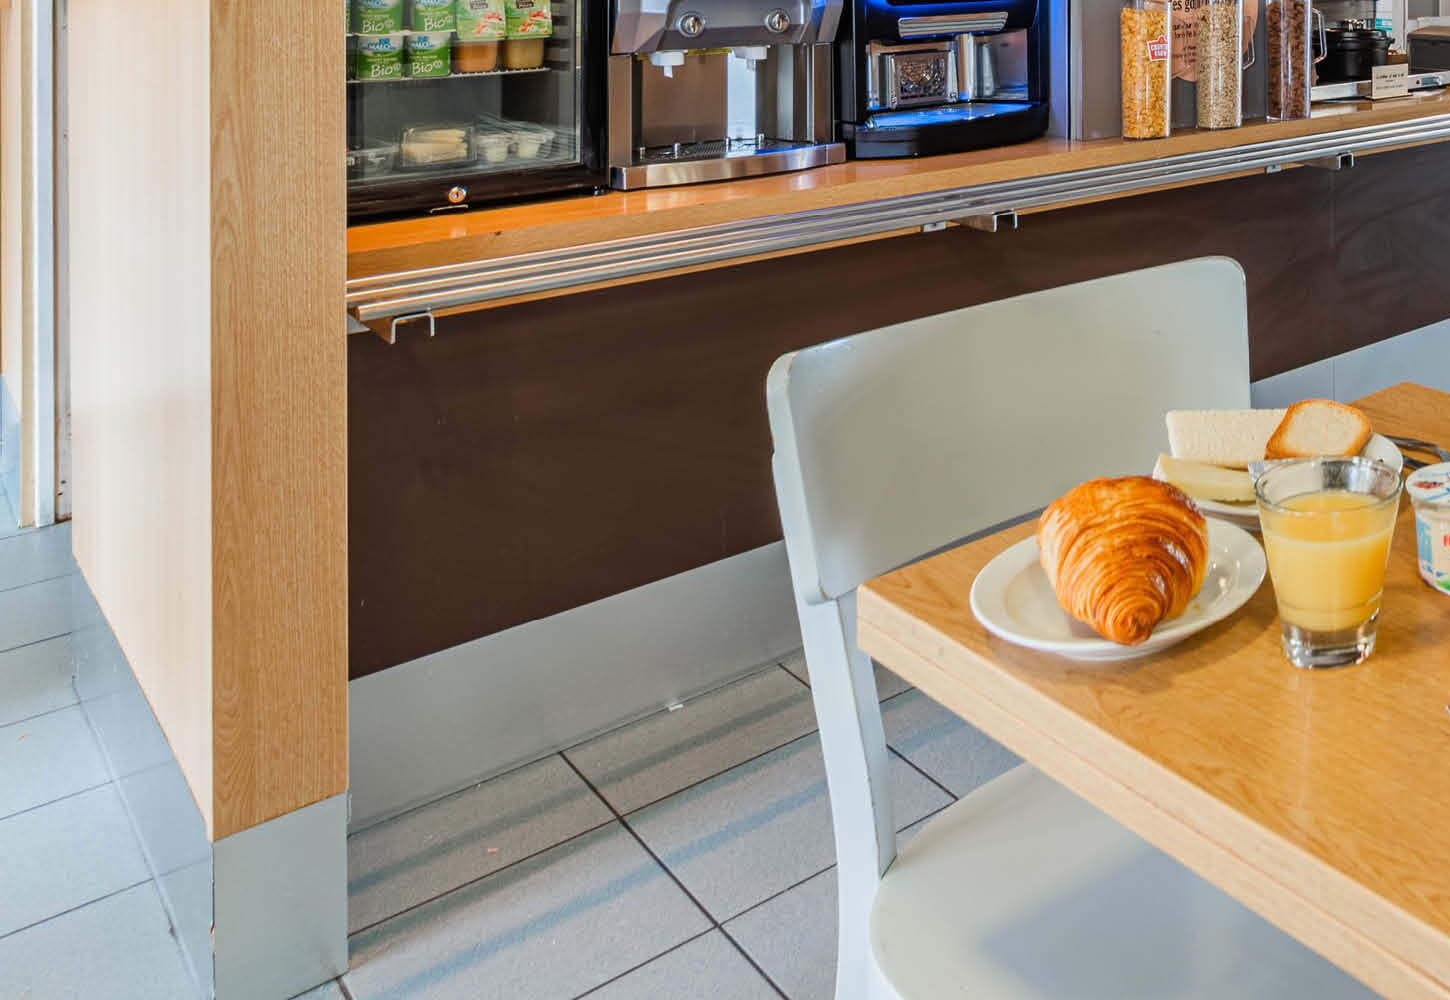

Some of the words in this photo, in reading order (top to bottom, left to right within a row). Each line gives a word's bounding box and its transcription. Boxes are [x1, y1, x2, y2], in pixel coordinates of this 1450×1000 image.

[362, 20, 385, 33] Bio
[424, 16, 445, 32] Bio
[371, 64, 392, 78] Bio
[412, 61, 432, 75] Bio
